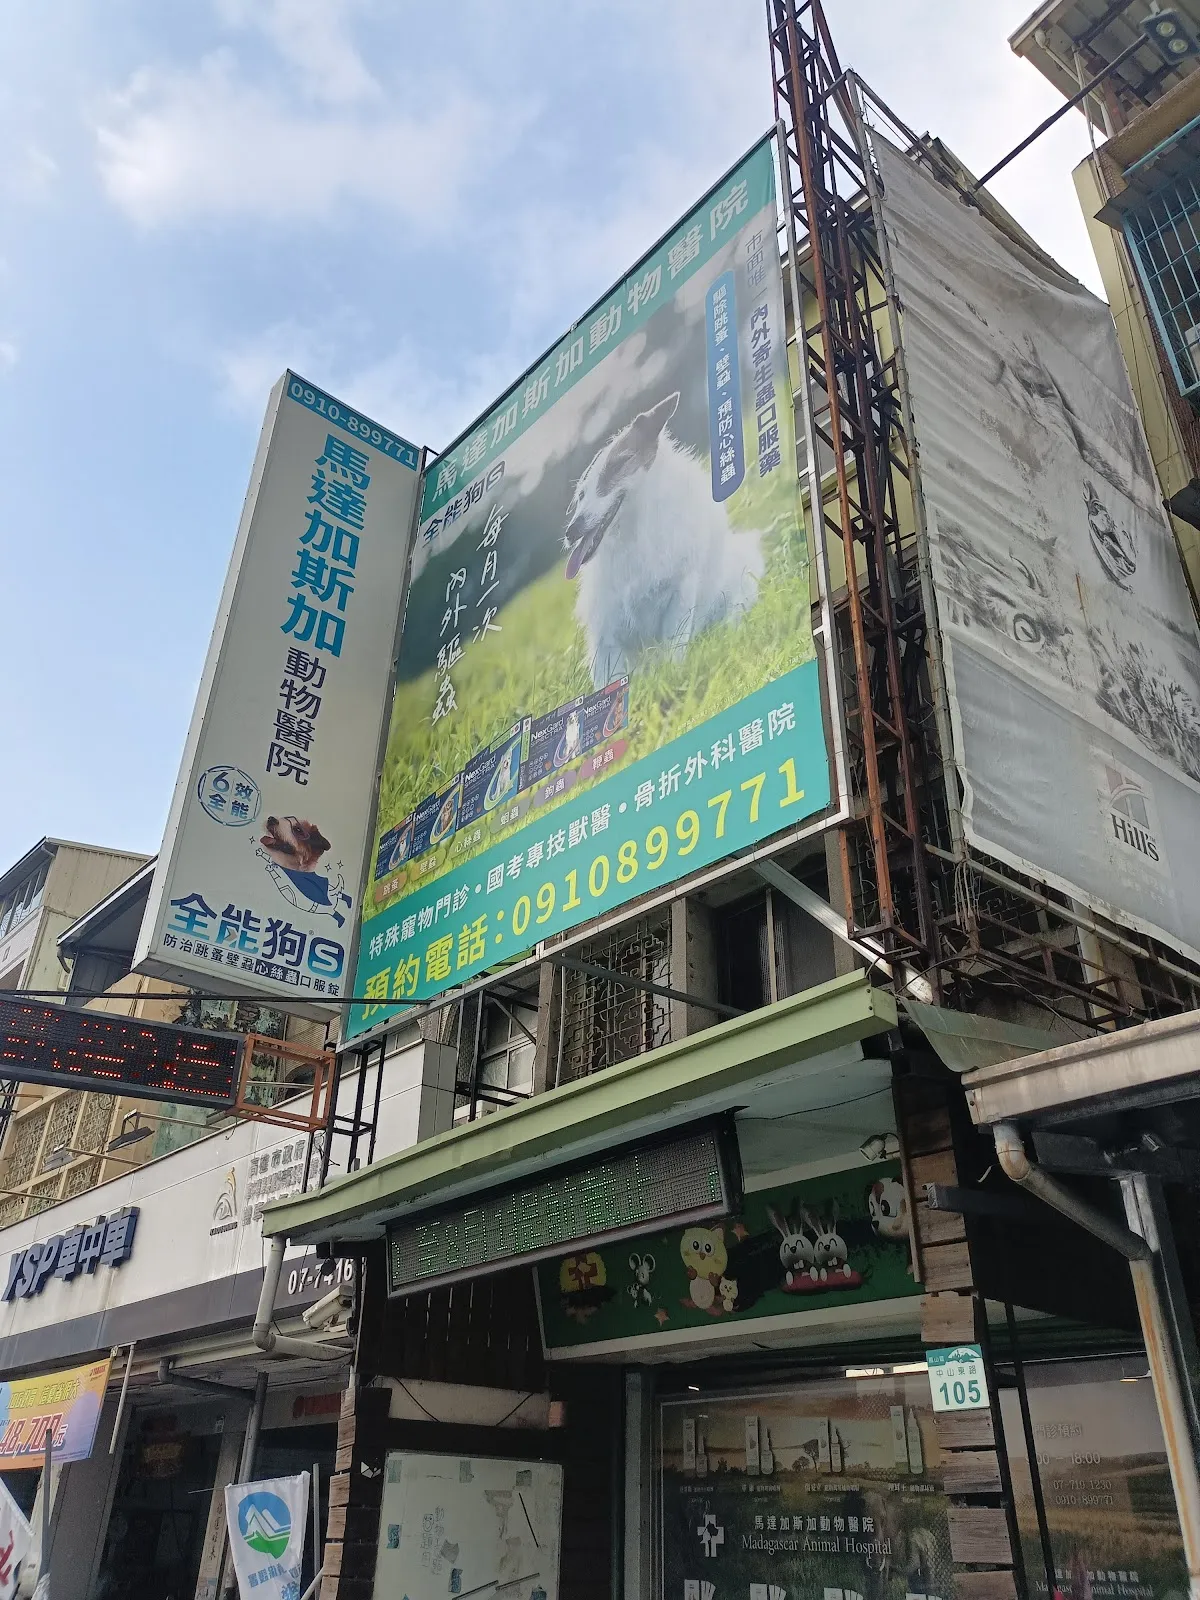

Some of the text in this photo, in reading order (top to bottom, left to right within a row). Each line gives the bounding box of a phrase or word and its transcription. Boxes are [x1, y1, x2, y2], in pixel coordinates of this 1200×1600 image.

[431, 179, 749, 502] 馬達加斯加動物醫院
[290, 381, 417, 467] 0910-899771
[281, 433, 371, 659] 馬達加斯加
[472, 503, 509, 644] 每月一次
[265, 646, 328, 787] 動物醫院
[531, 719, 564, 742] NexGard
[465, 755, 496, 781] NexGard
[936, 1365, 977, 1378] 中山東路
[940, 1380, 981, 1406] 105
[1071, 1452, 1101, 1464] 18:00
[754, 1515, 875, 1533] 馬達加斯加動物醫院
[742, 1535, 892, 1559] Madagascar Animal Hospital
